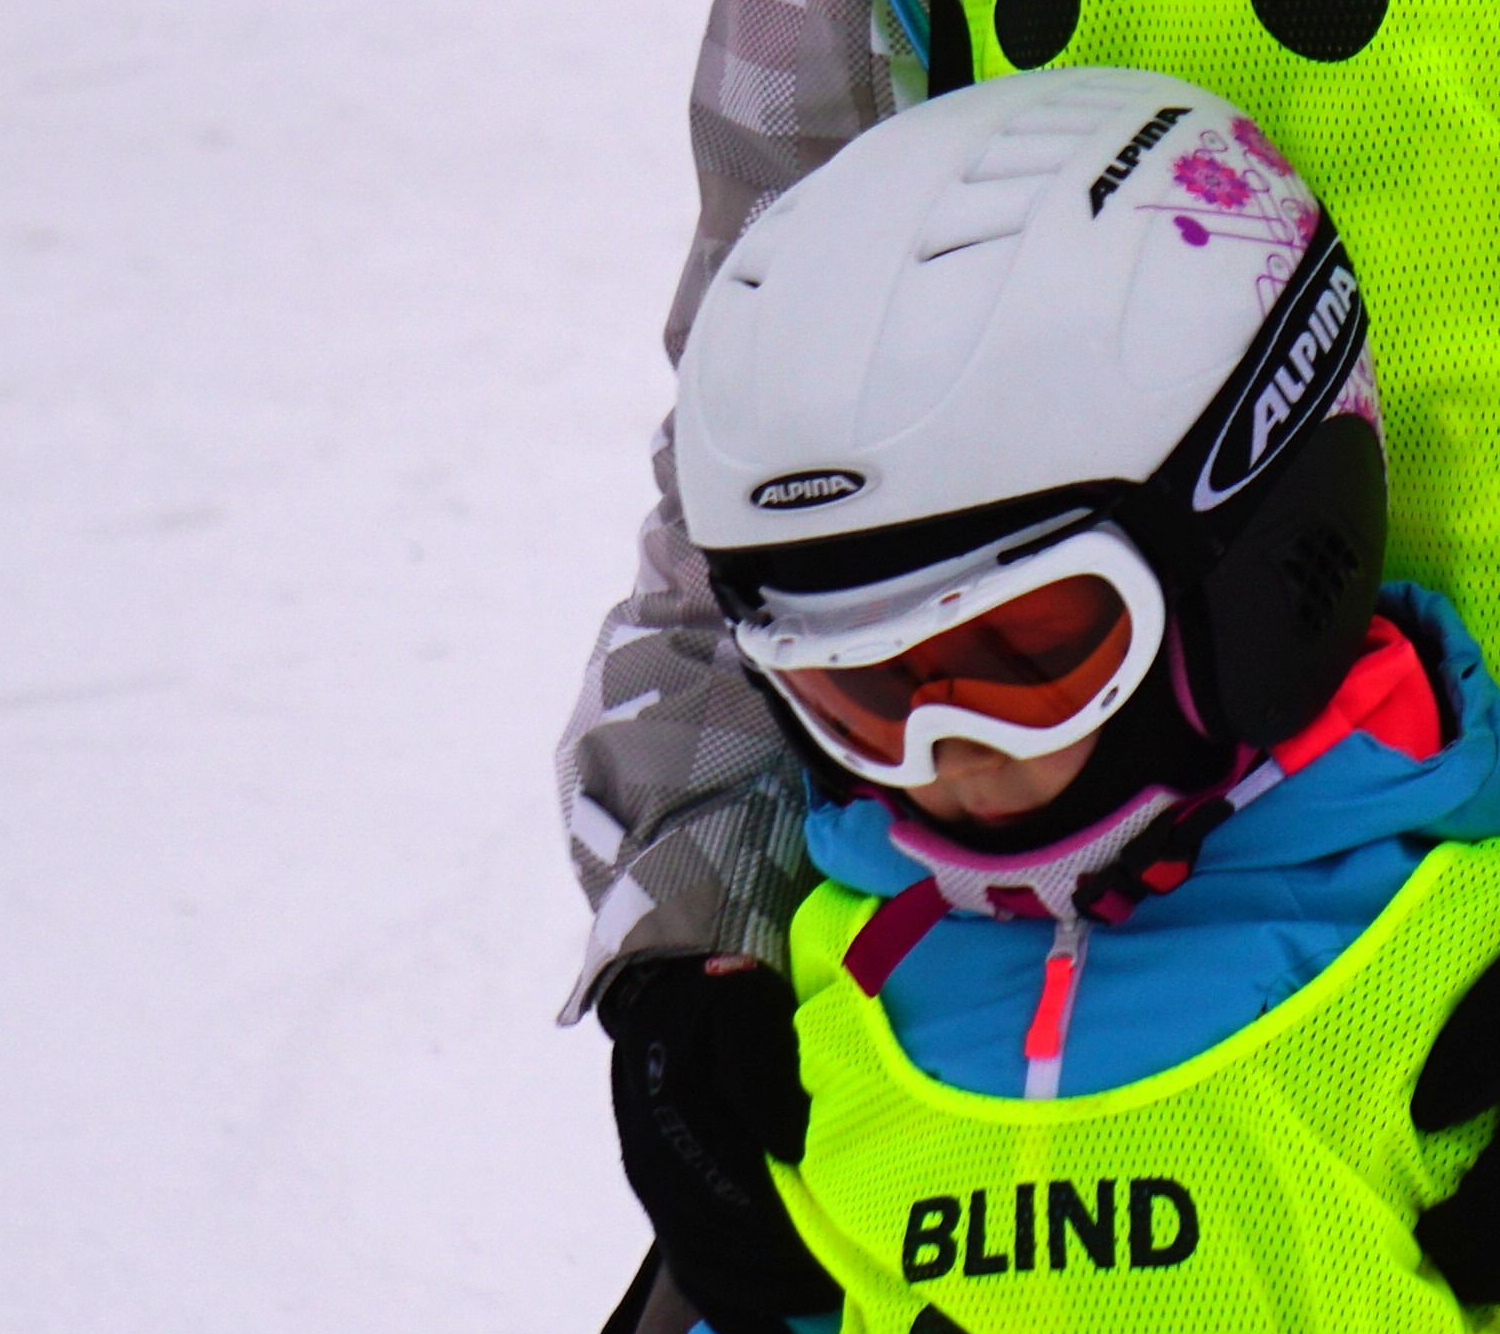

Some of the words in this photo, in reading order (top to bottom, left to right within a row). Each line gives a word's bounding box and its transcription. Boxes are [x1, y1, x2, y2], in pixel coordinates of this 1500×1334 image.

[1089, 106, 1194, 220] ALPINA
[1249, 265, 1358, 471] ALPINA
[758, 474, 860, 507] ALPINA
[901, 1176, 1200, 1284] BLIND
